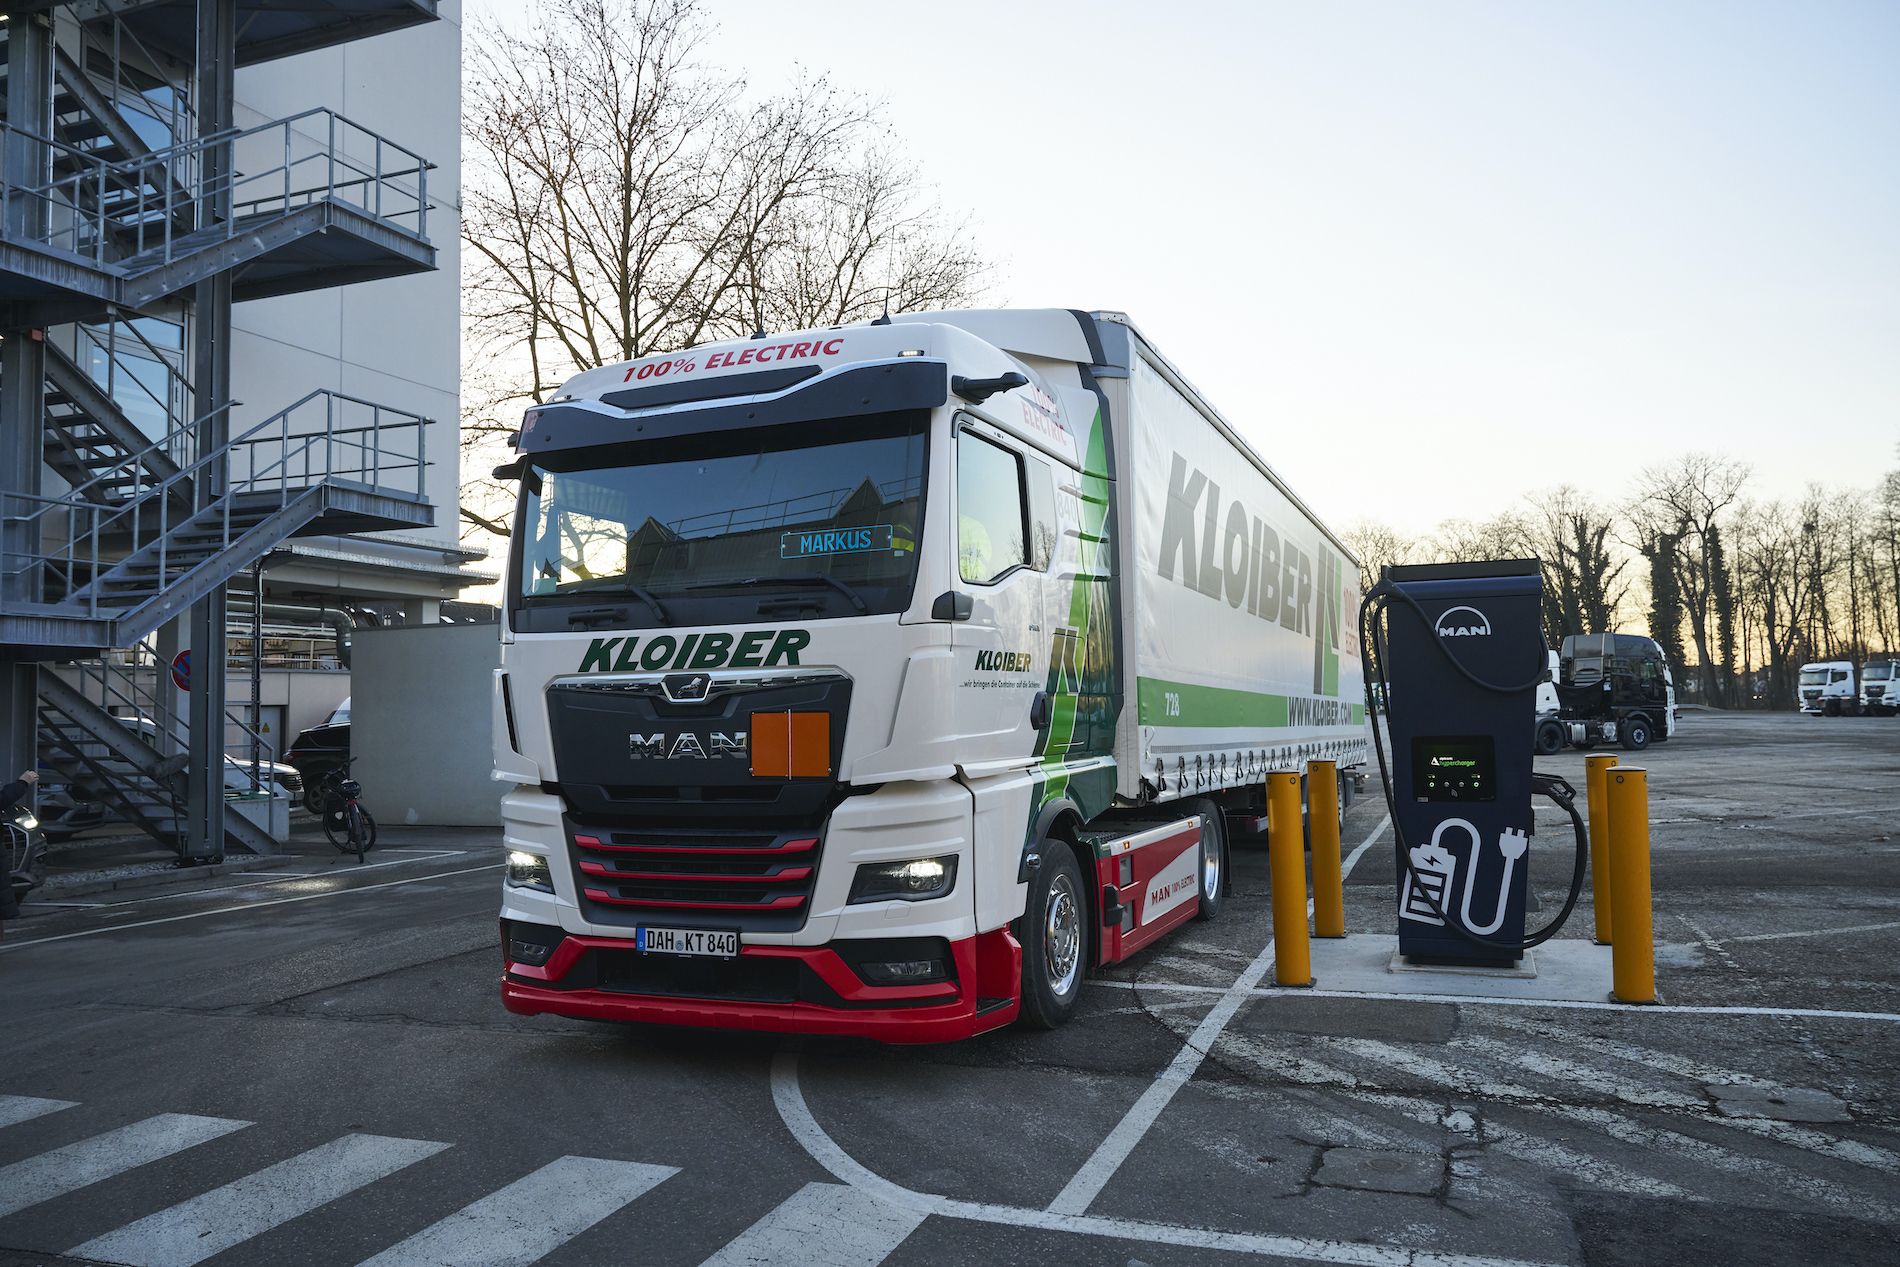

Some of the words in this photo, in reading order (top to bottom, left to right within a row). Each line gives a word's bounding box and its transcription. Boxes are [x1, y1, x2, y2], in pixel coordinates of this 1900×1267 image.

[623, 361, 696, 383] 100%
[704, 338, 844, 370] ELECTRIC
[801, 530, 871, 553] MARKUS
[1158, 450, 1311, 637] KLOIBER
[1440, 626, 1486, 637] MAN
[578, 639, 811, 672] KLOIBER
[975, 650, 1031, 672] KLOIBER
[1165, 692, 1180, 717] 728
[1288, 697, 1352, 727] WWW.KLOIBER.COM
[629, 732, 748, 760] MAN
[1151, 884, 1171, 906] MAN
[646, 930, 674, 950] DAH
[685, 932, 704, 952] KT
[707, 934, 736, 954] 840
